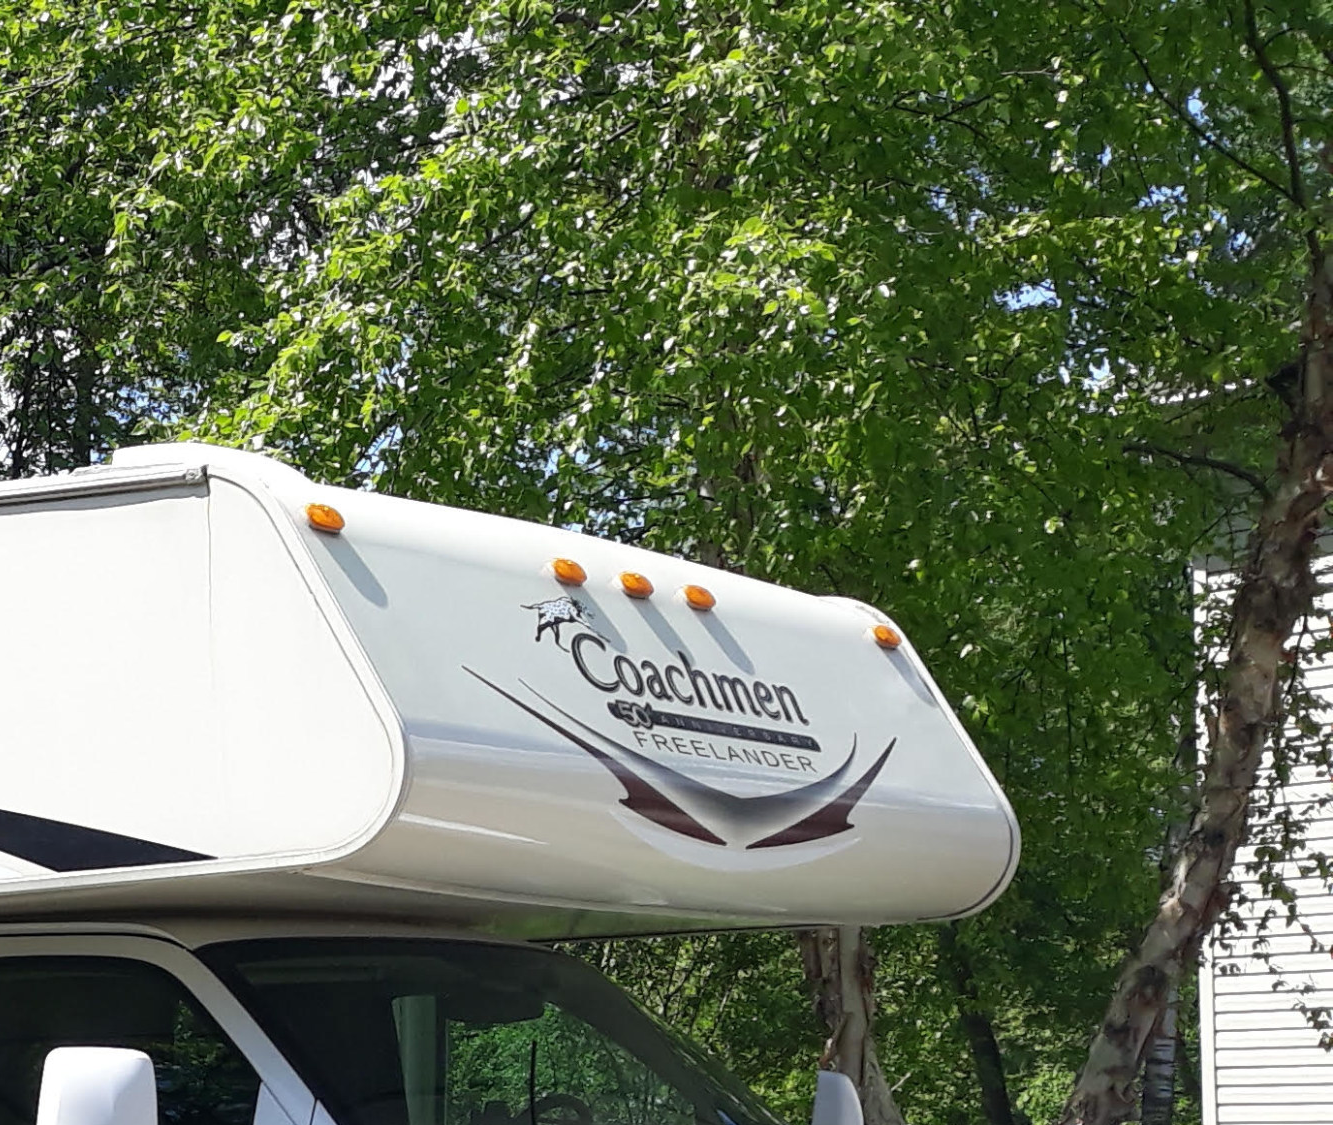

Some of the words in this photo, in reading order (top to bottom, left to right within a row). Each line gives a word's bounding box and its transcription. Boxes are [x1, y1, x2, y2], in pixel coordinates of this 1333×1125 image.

[570, 632, 810, 726] Coachmen
[633, 731, 818, 773] FREELANDER
[660, 714, 815, 749] ANNERSARY
